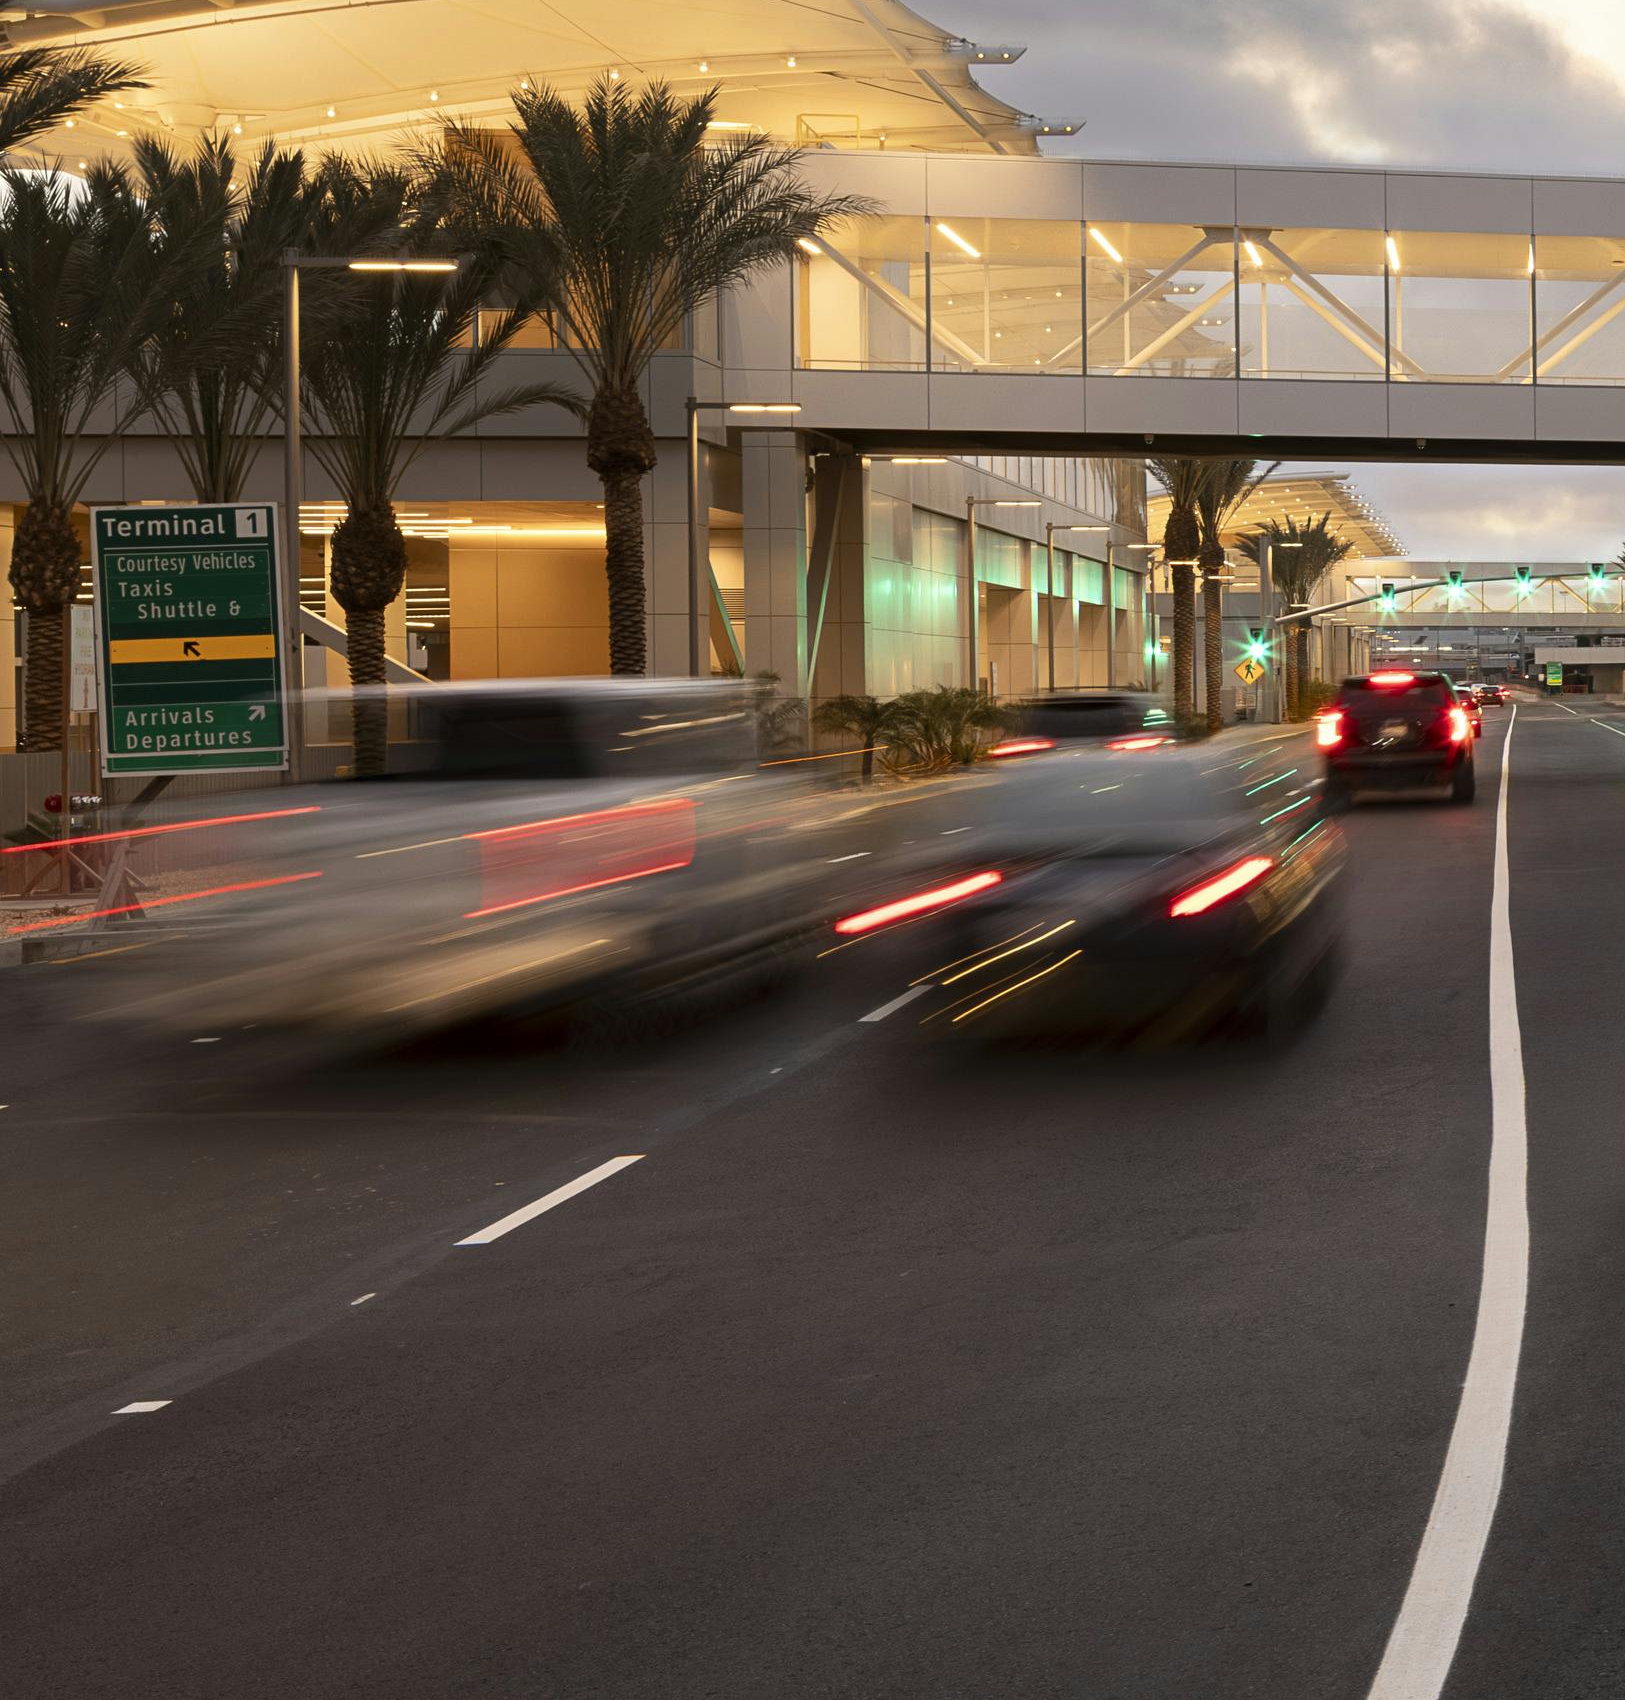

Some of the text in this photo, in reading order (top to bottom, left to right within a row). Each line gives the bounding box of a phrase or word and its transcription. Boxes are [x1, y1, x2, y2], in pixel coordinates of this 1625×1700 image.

[102, 512, 257, 537] Terminal 1
[117, 553, 256, 575] Courtesy Vehicles
[118, 579, 173, 597] Taxis
[138, 600, 241, 619] Shuttle &
[125, 708, 214, 726] Arrivals
[127, 730, 252, 751] Departures
